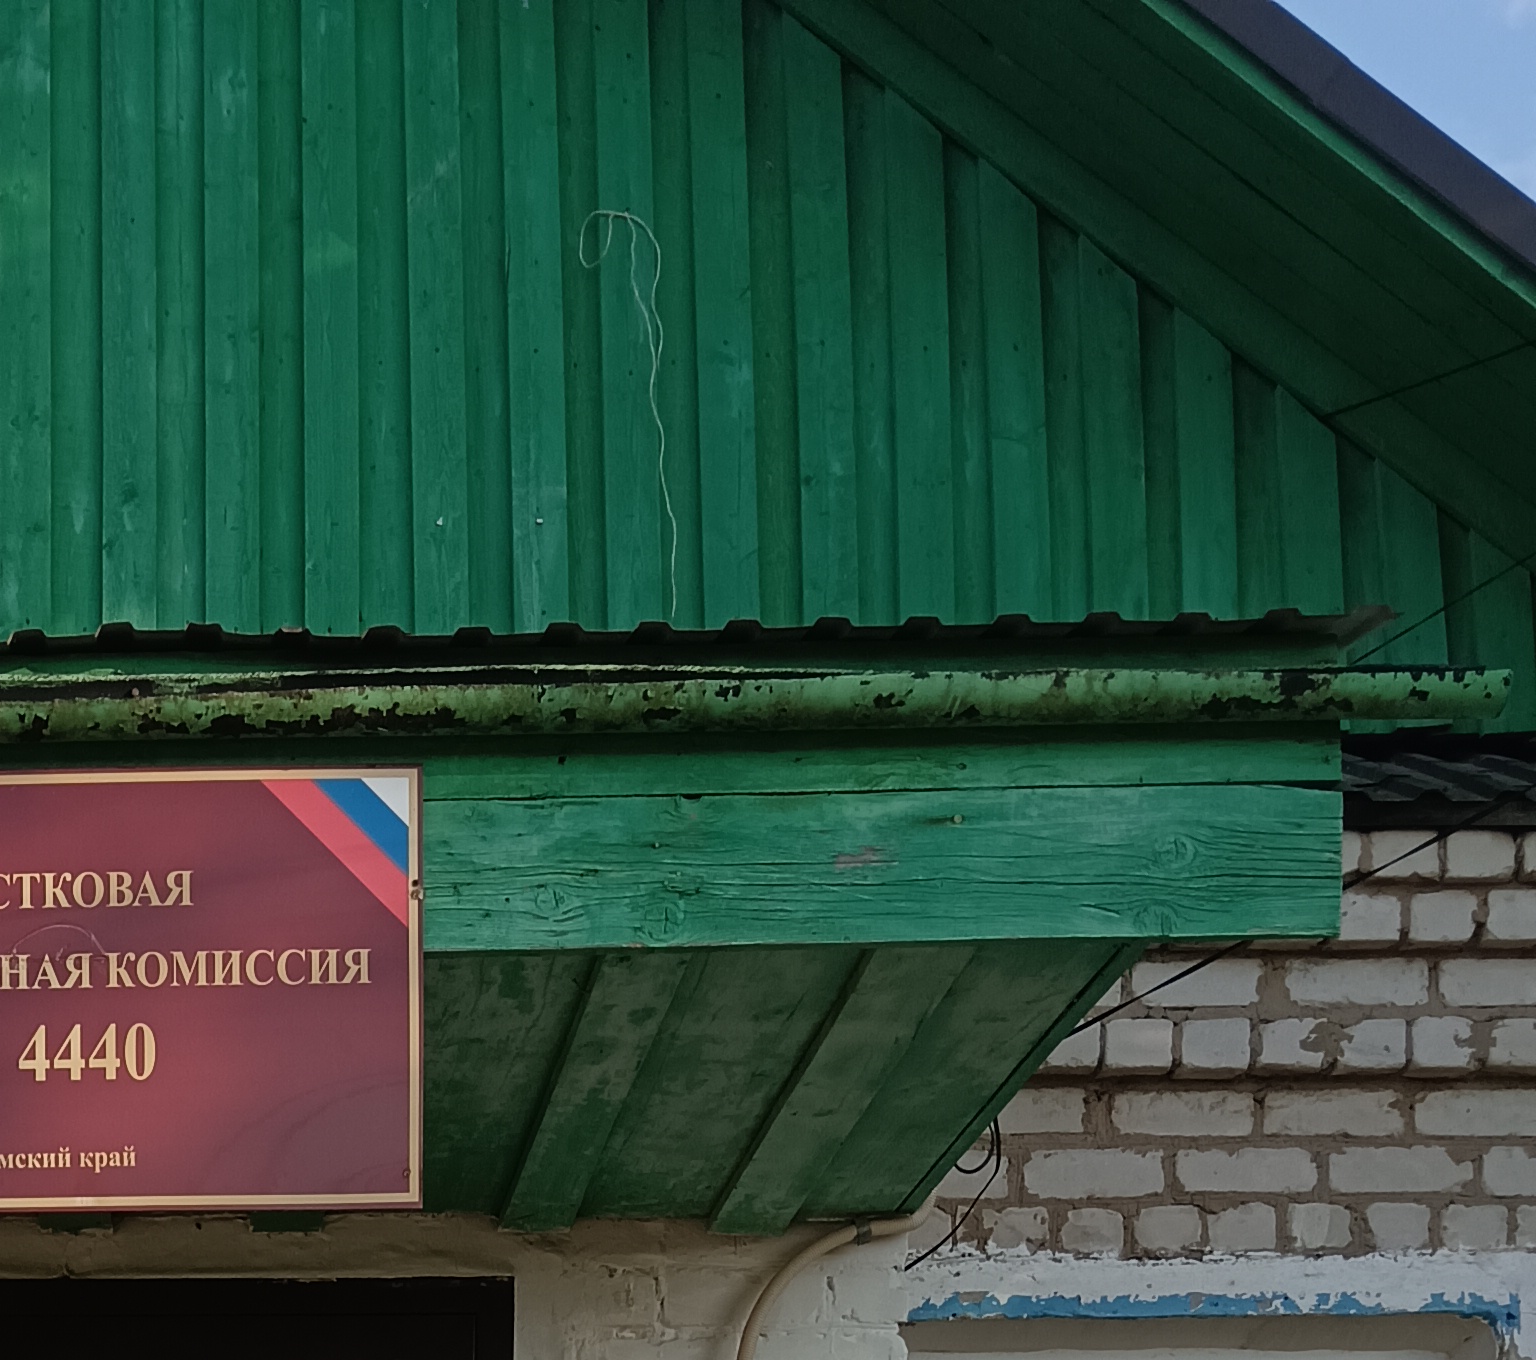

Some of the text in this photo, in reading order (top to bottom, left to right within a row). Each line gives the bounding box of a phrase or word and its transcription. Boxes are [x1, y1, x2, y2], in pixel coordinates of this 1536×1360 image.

[105, 949, 371, 987] КОМИССИЯ
[19, 1023, 155, 1081] 4440
[80, 1146, 135, 1173] край
